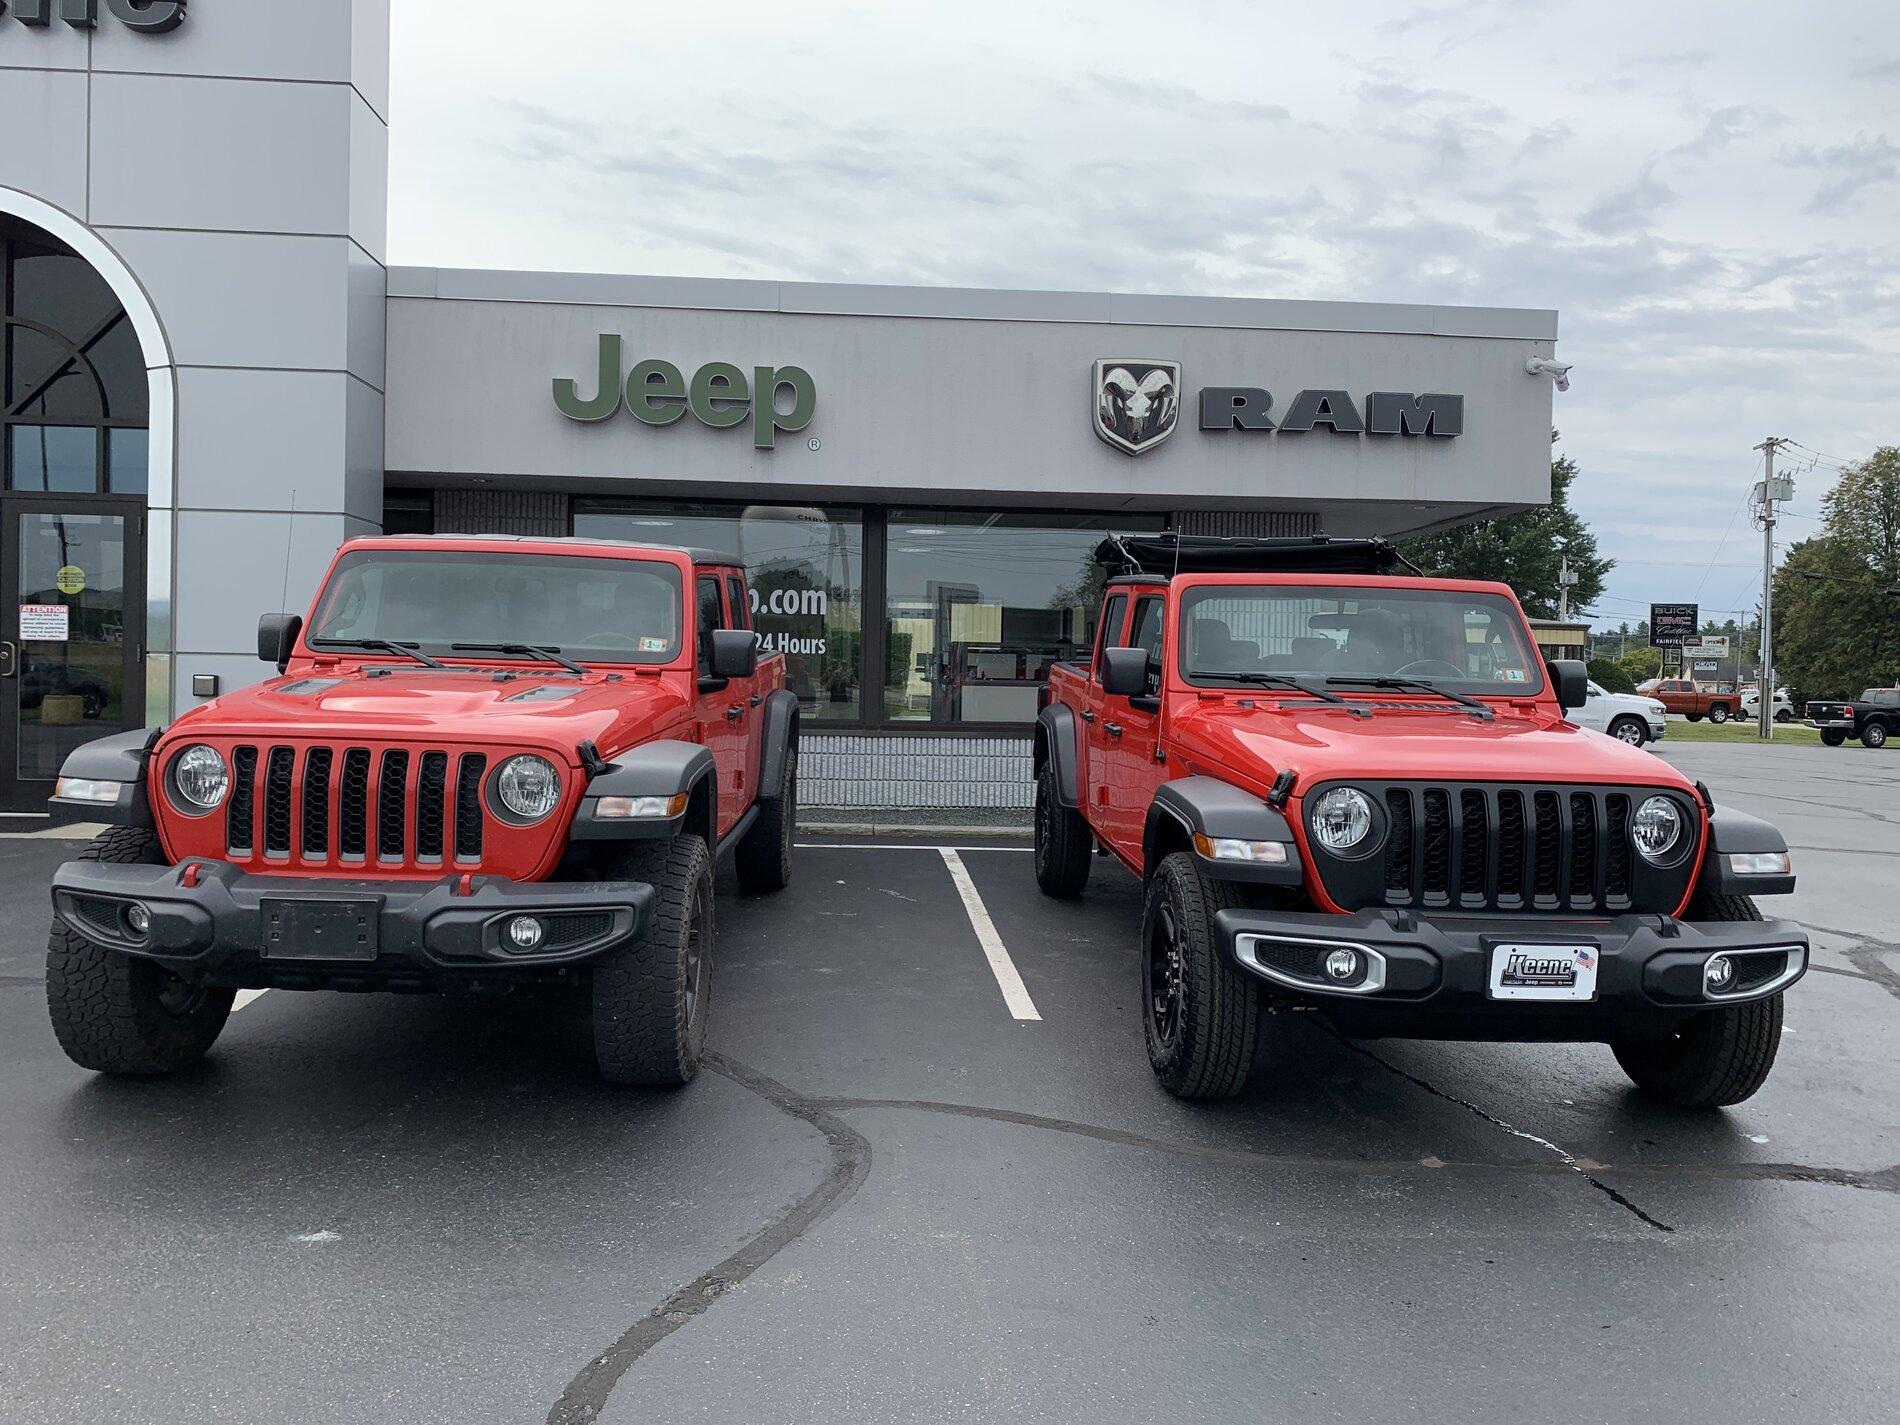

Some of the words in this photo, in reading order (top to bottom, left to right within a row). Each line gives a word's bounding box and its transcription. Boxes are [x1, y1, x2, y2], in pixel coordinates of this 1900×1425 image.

[552, 333, 817, 450] Jeep
[1199, 386, 1464, 437] RAM
[778, 632, 826, 655] Hours
[1507, 955, 1573, 975] Keene
